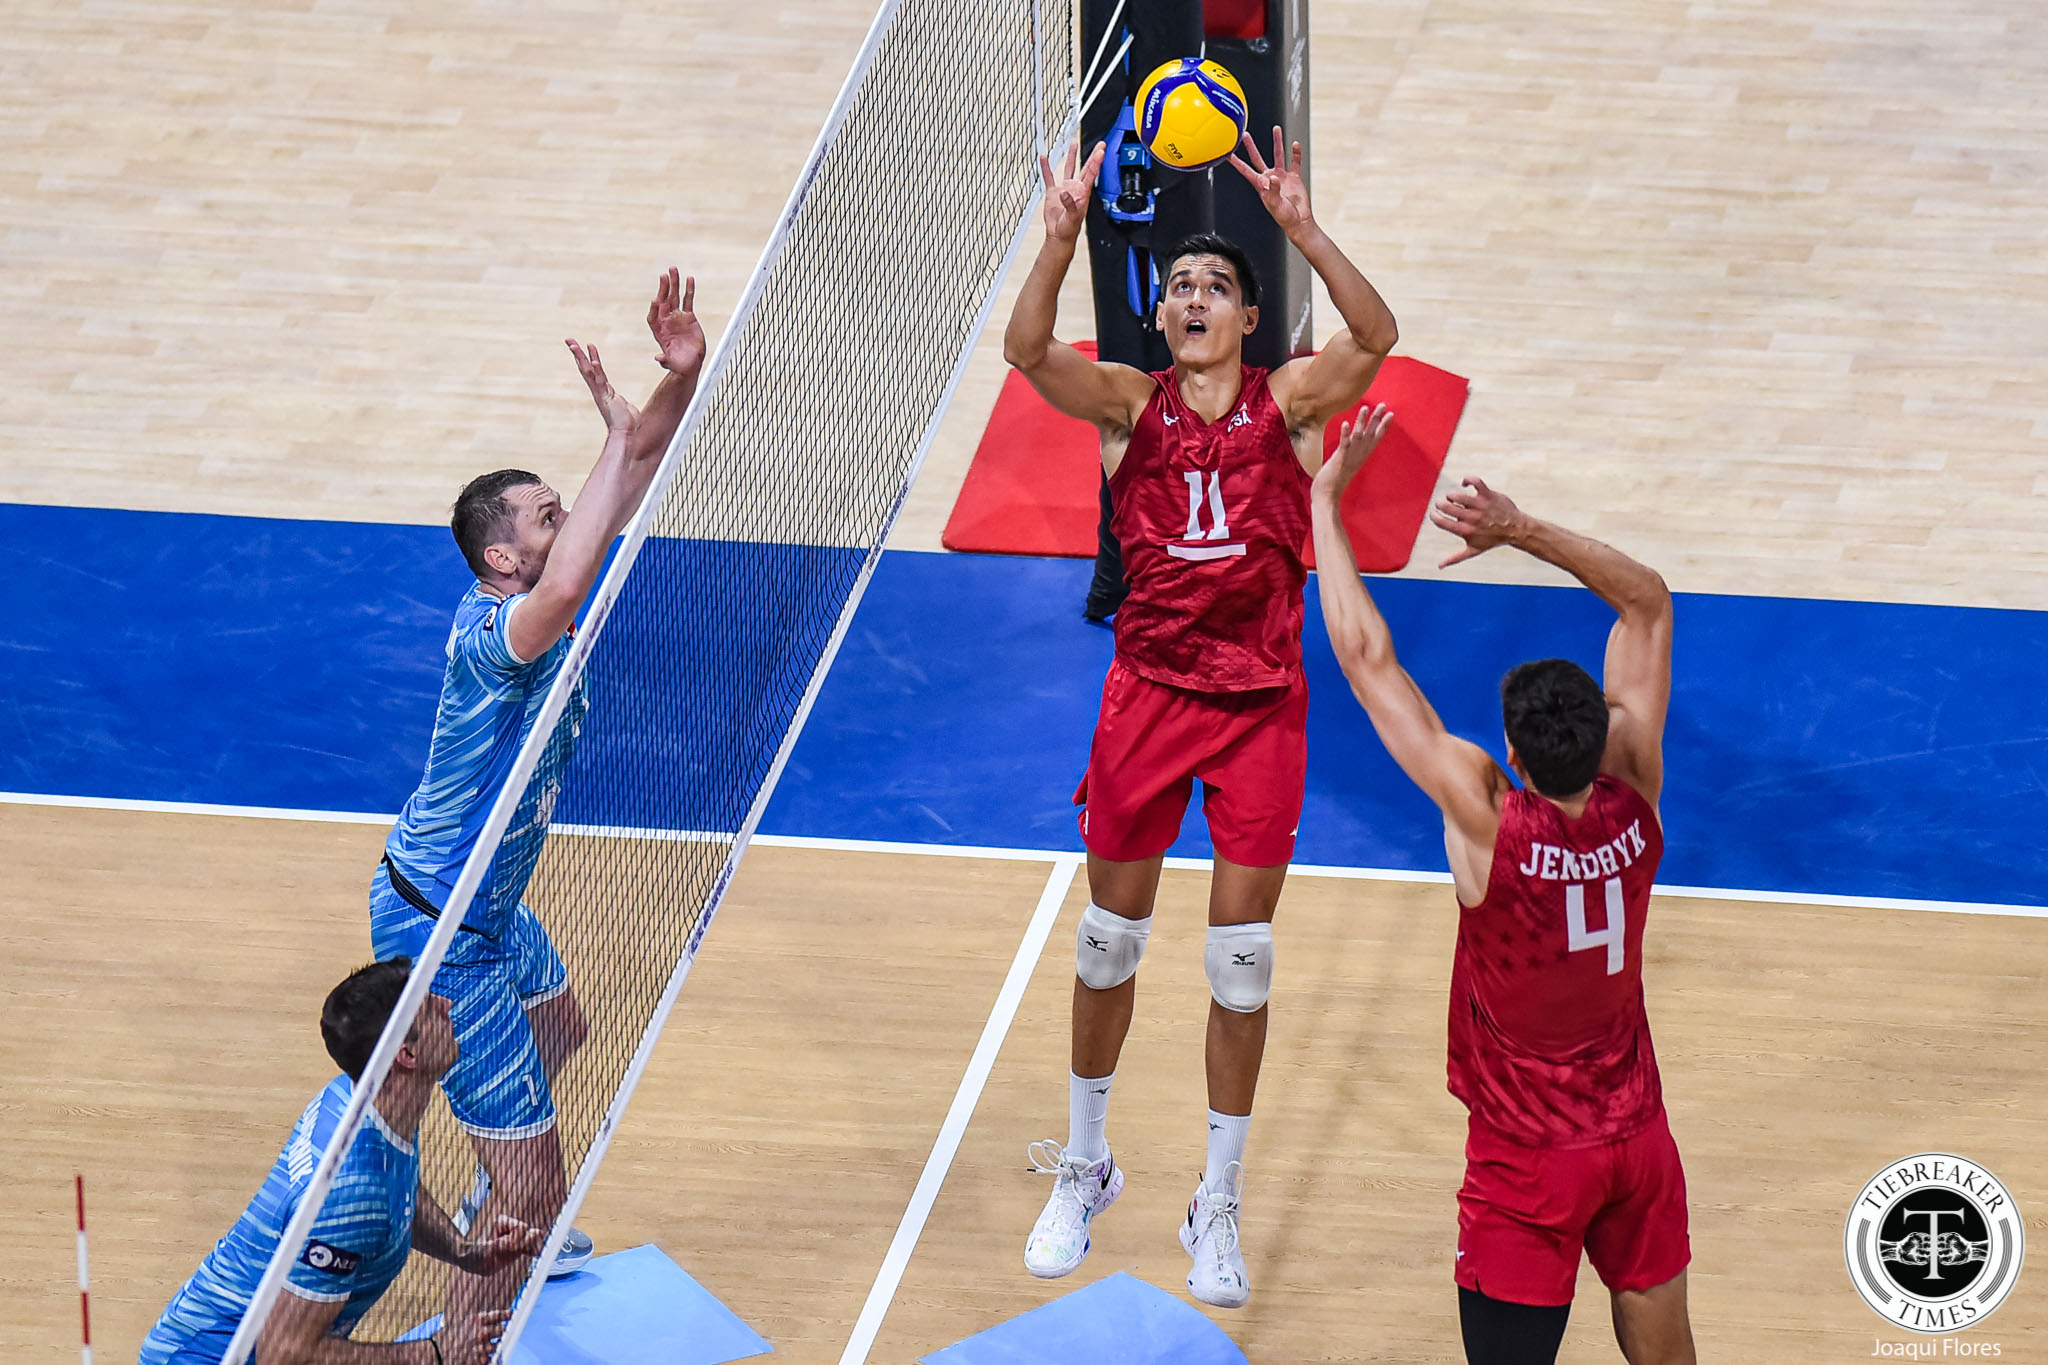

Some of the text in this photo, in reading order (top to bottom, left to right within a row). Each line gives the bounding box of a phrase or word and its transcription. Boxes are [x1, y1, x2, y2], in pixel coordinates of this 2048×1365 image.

[1127, 150, 1137, 160] 9
[1183, 469, 1230, 541] 11
[1519, 818, 1647, 880] JENDRYK
[1565, 876, 1626, 976] 4
[522, 1074, 538, 1107] 1
